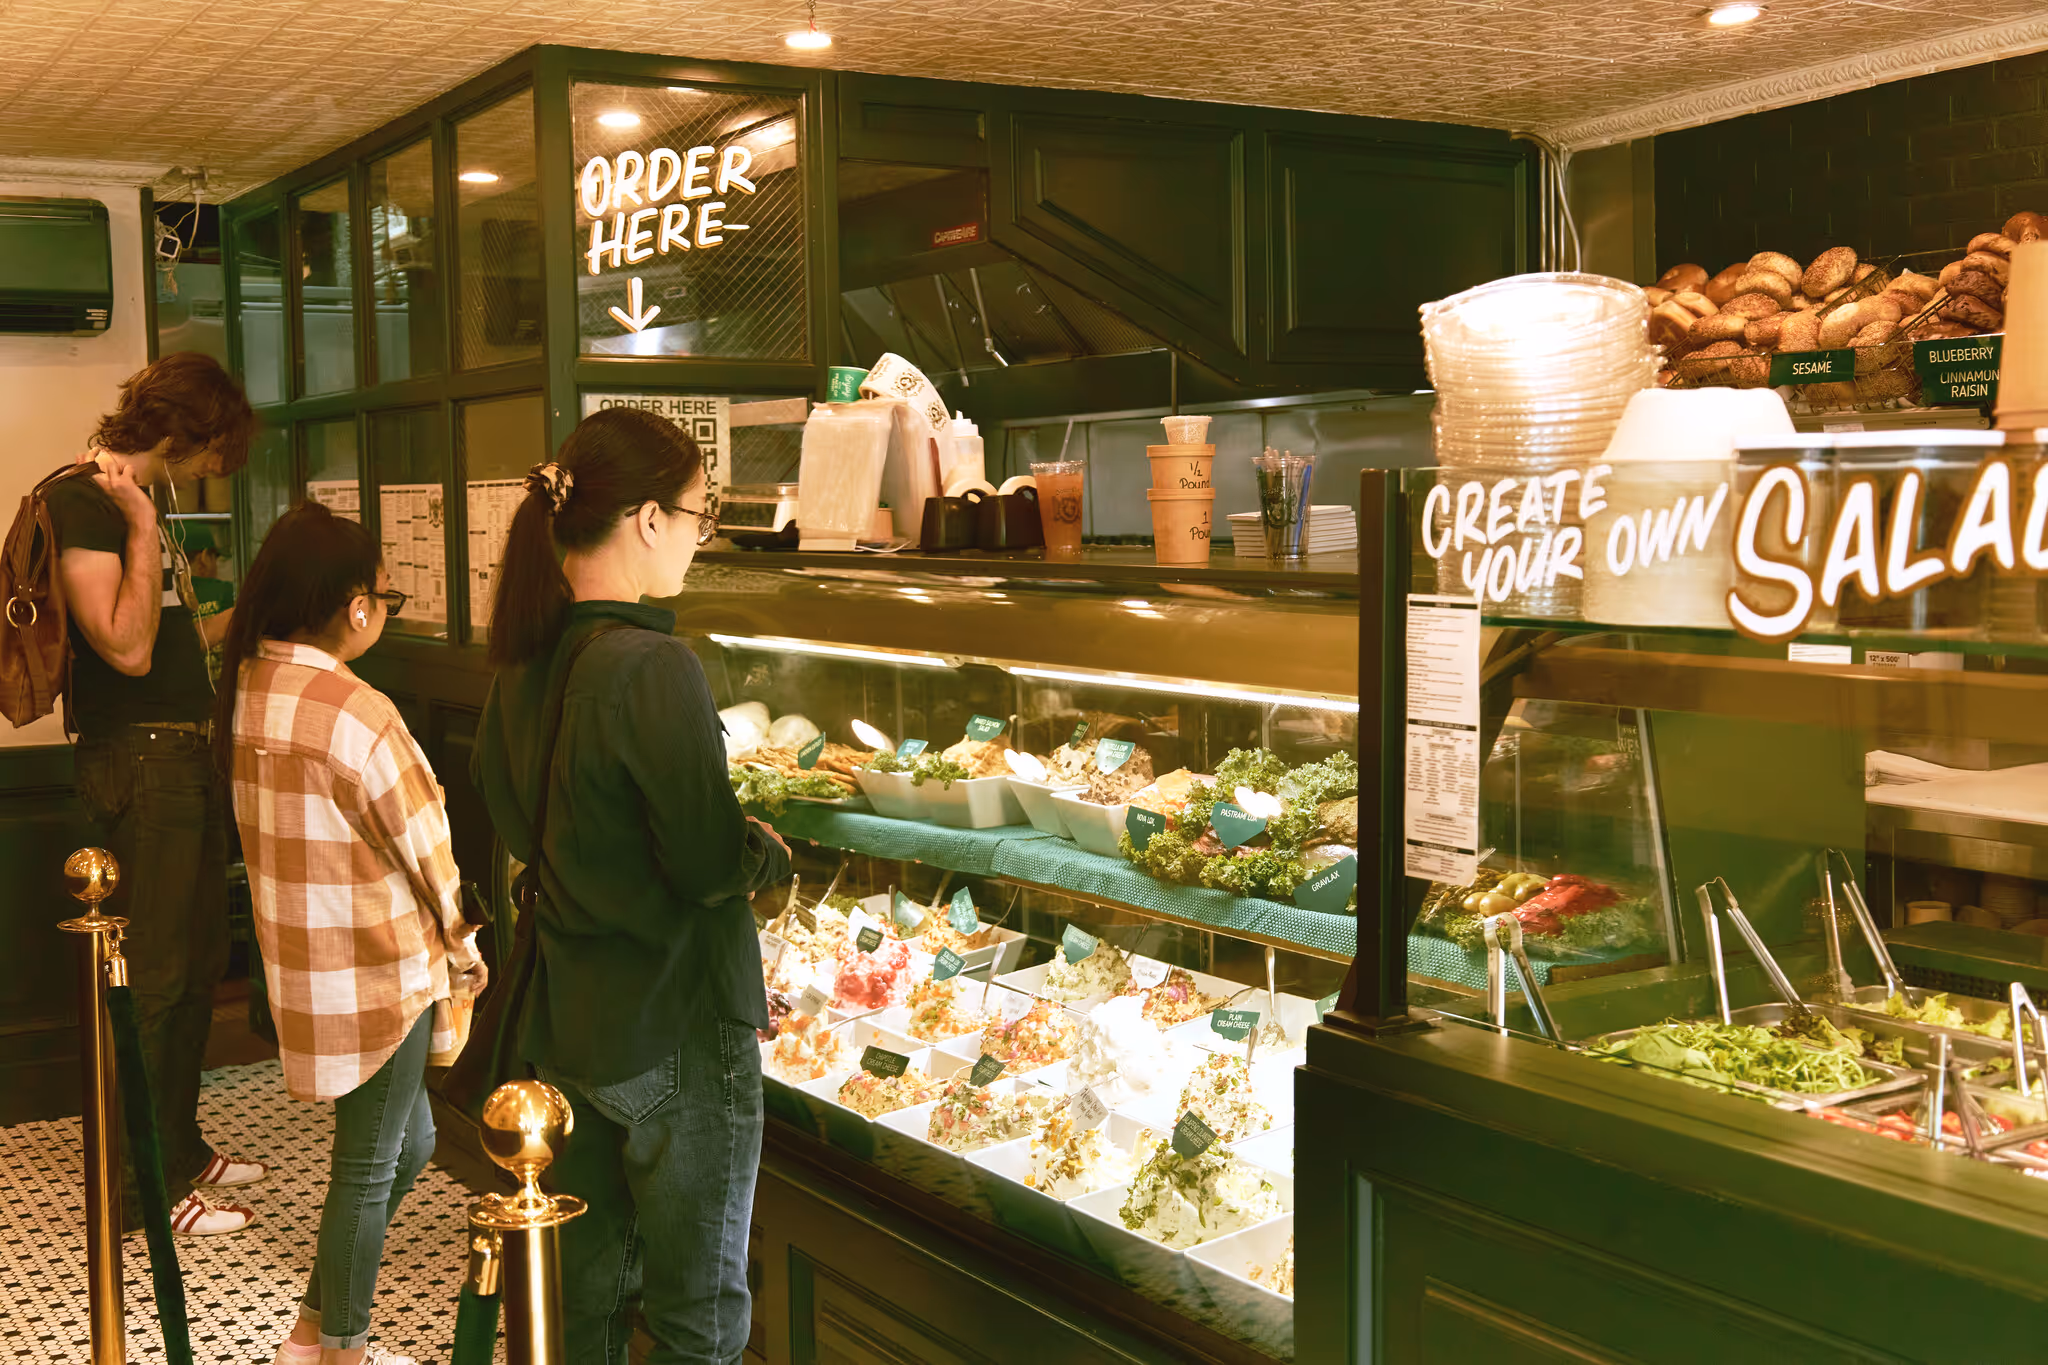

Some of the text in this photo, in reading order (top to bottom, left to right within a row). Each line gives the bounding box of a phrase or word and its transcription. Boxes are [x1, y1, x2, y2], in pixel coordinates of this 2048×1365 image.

[580, 146, 757, 219] ORDER
[1929, 346, 1994, 363] BLUEBERRY
[841, 374, 855, 398] Enjoy
[1951, 383, 1988, 398] RAISIN
[669, 400, 717, 415] HERE
[1201, 510, 1209, 525] 1
[1422, 464, 1612, 558] CREATE
[1462, 527, 1583, 604] YOUR
[1607, 482, 1728, 576] OWN
[1136, 813, 1147, 824] NOVA
[1220, 808, 1247, 820] PASTRAMI
[1311, 870, 1340, 892] GRAVLAX
[1216, 1020, 1251, 1029] CREAM CHEESE
[1228, 1013, 1243, 1021] PLAIN
[867, 1057, 900, 1073] CREAM CHEESE
[875, 1052, 897, 1064] CHIPOTLE
[1180, 1125, 1204, 1149] CREAM CHEESE
